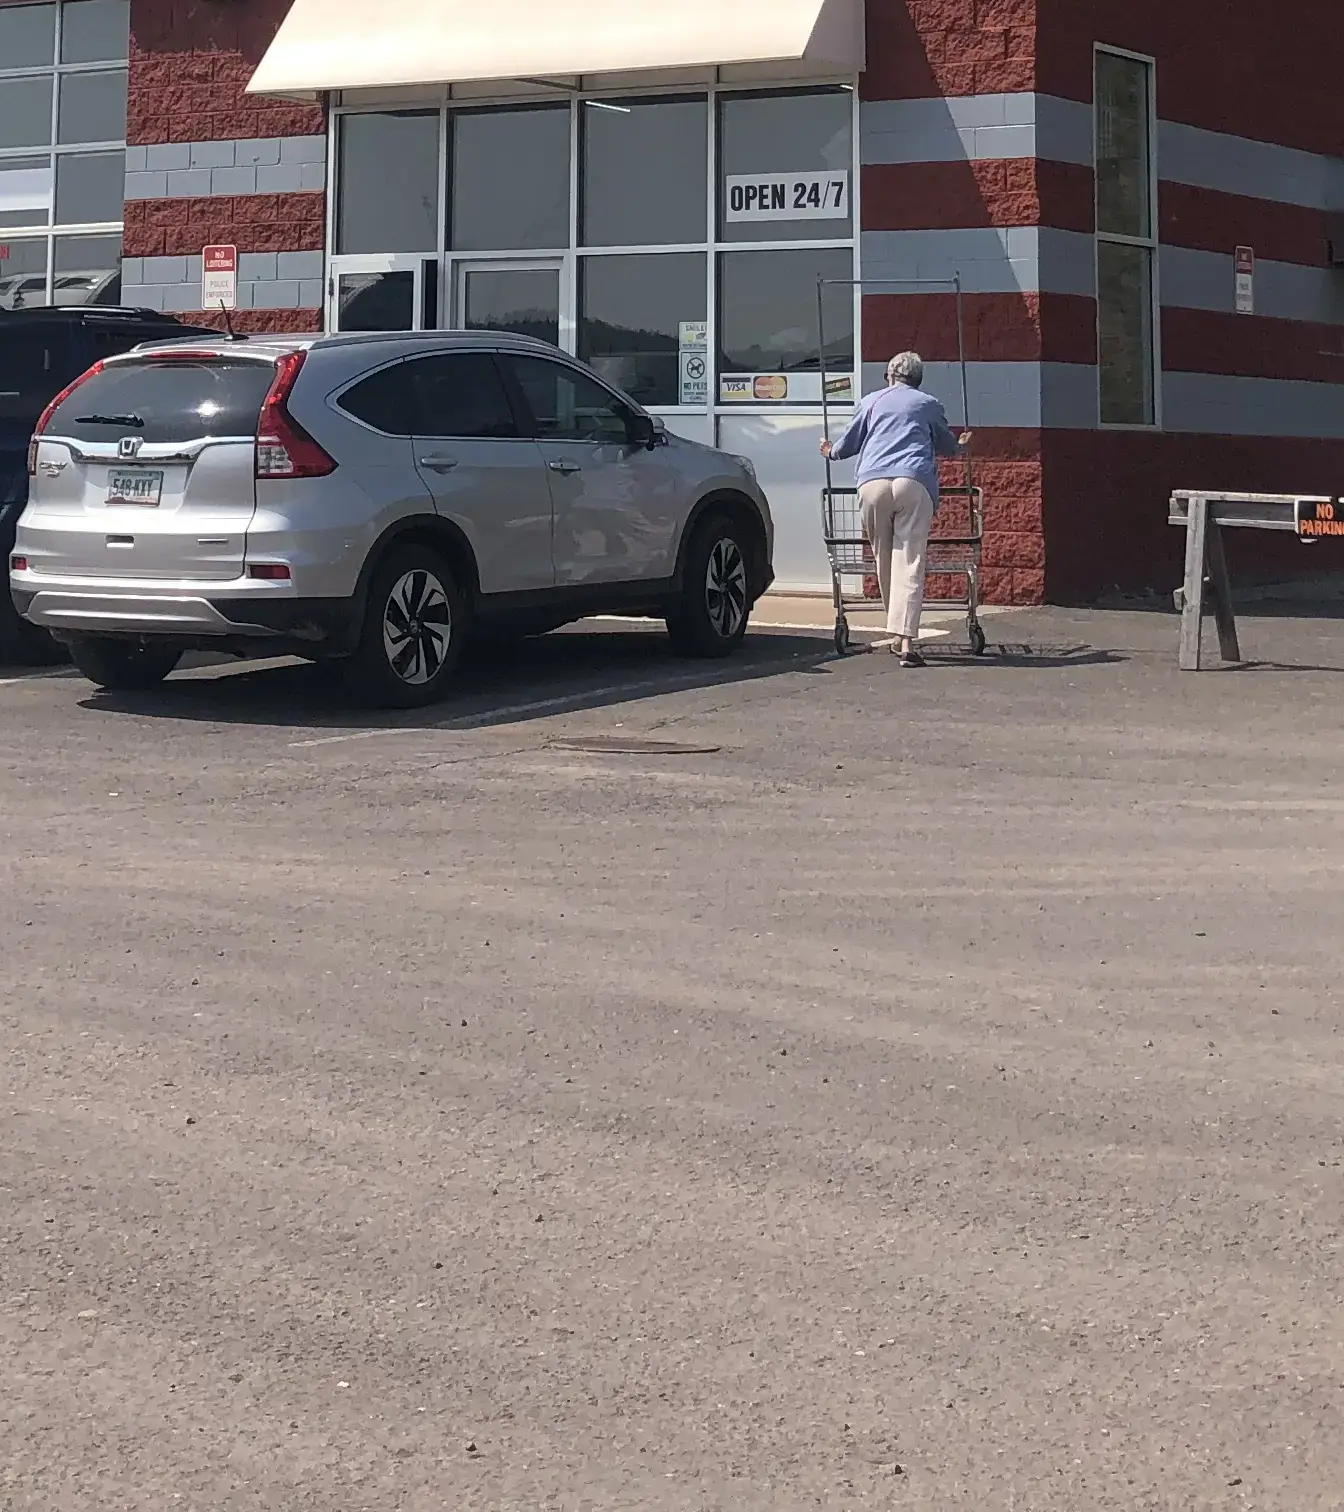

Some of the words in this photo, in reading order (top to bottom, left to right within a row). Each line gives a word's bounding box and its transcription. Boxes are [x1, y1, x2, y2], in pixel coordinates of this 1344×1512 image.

[730, 183, 786, 212] OPEN
[793, 180, 844, 209] 24/7
[214, 250, 225, 259] NO
[726, 382, 746, 392] VISA
[1316, 503, 1334, 519] NO
